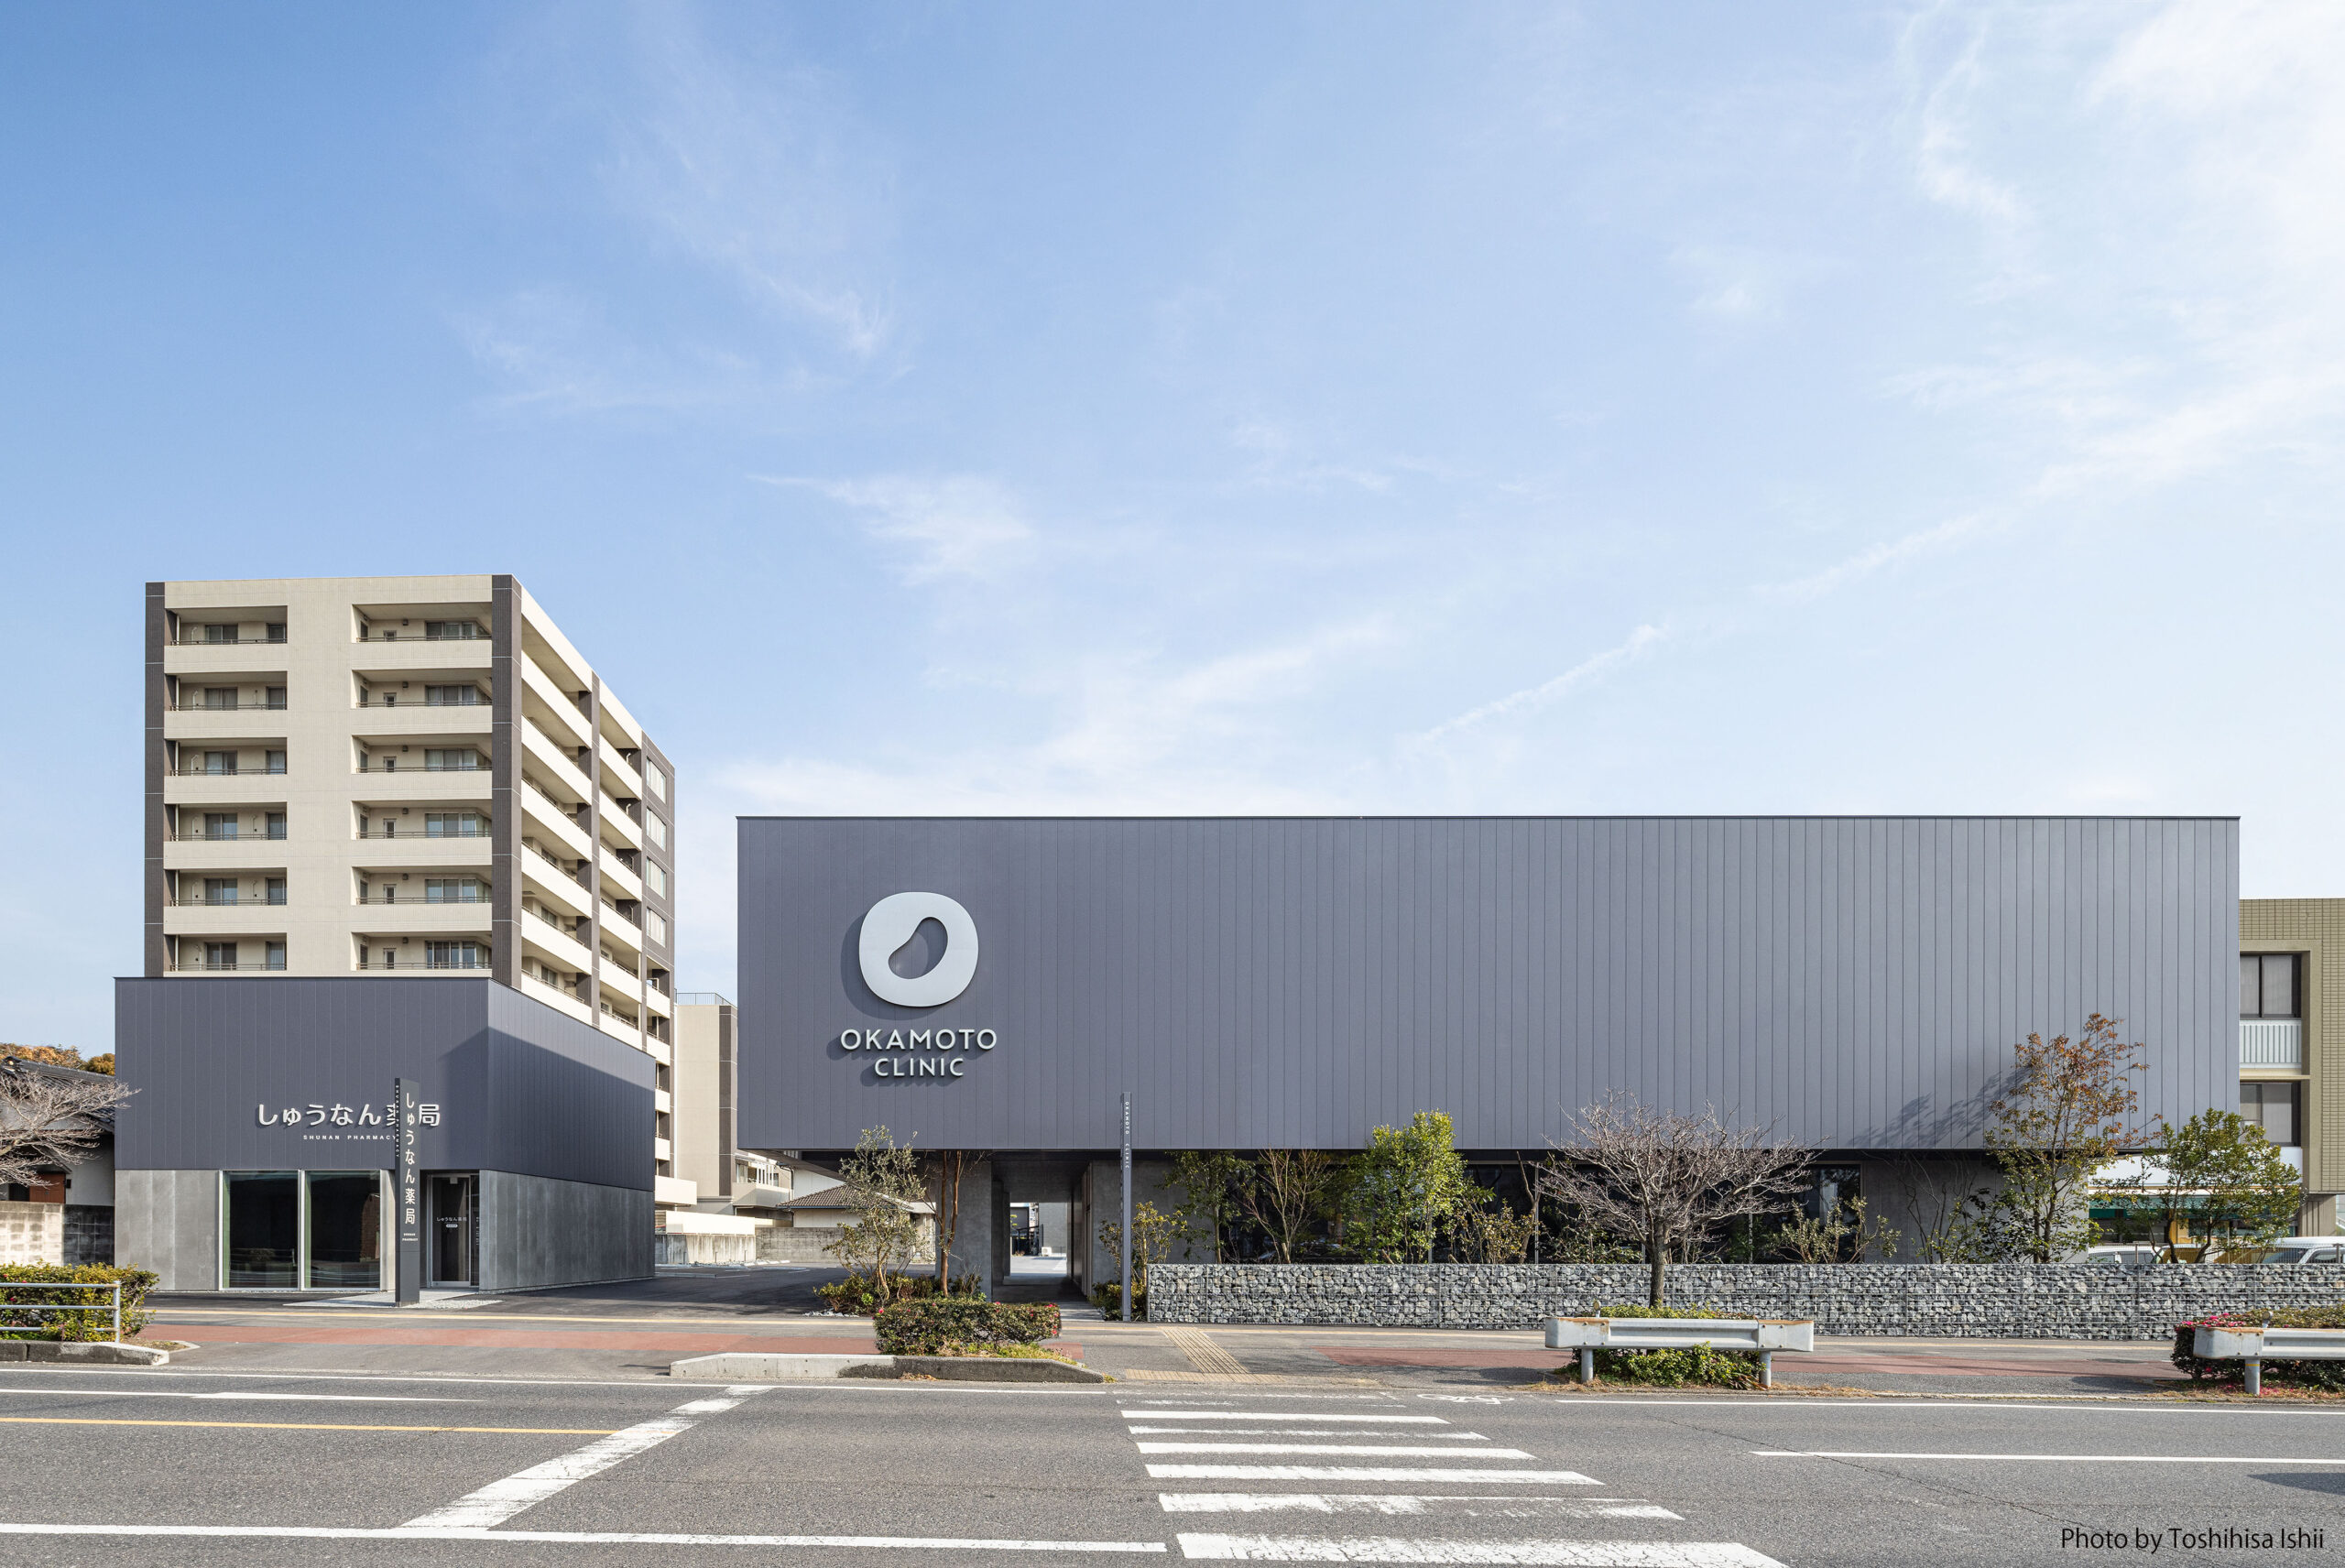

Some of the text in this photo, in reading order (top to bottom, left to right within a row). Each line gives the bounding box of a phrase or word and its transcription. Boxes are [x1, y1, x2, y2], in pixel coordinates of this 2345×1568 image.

[840, 1029, 998, 1051] OKAMOTO
[874, 1058, 965, 1077] CLINIC
[405, 1093, 416, 1225] しゅうなん薬局
